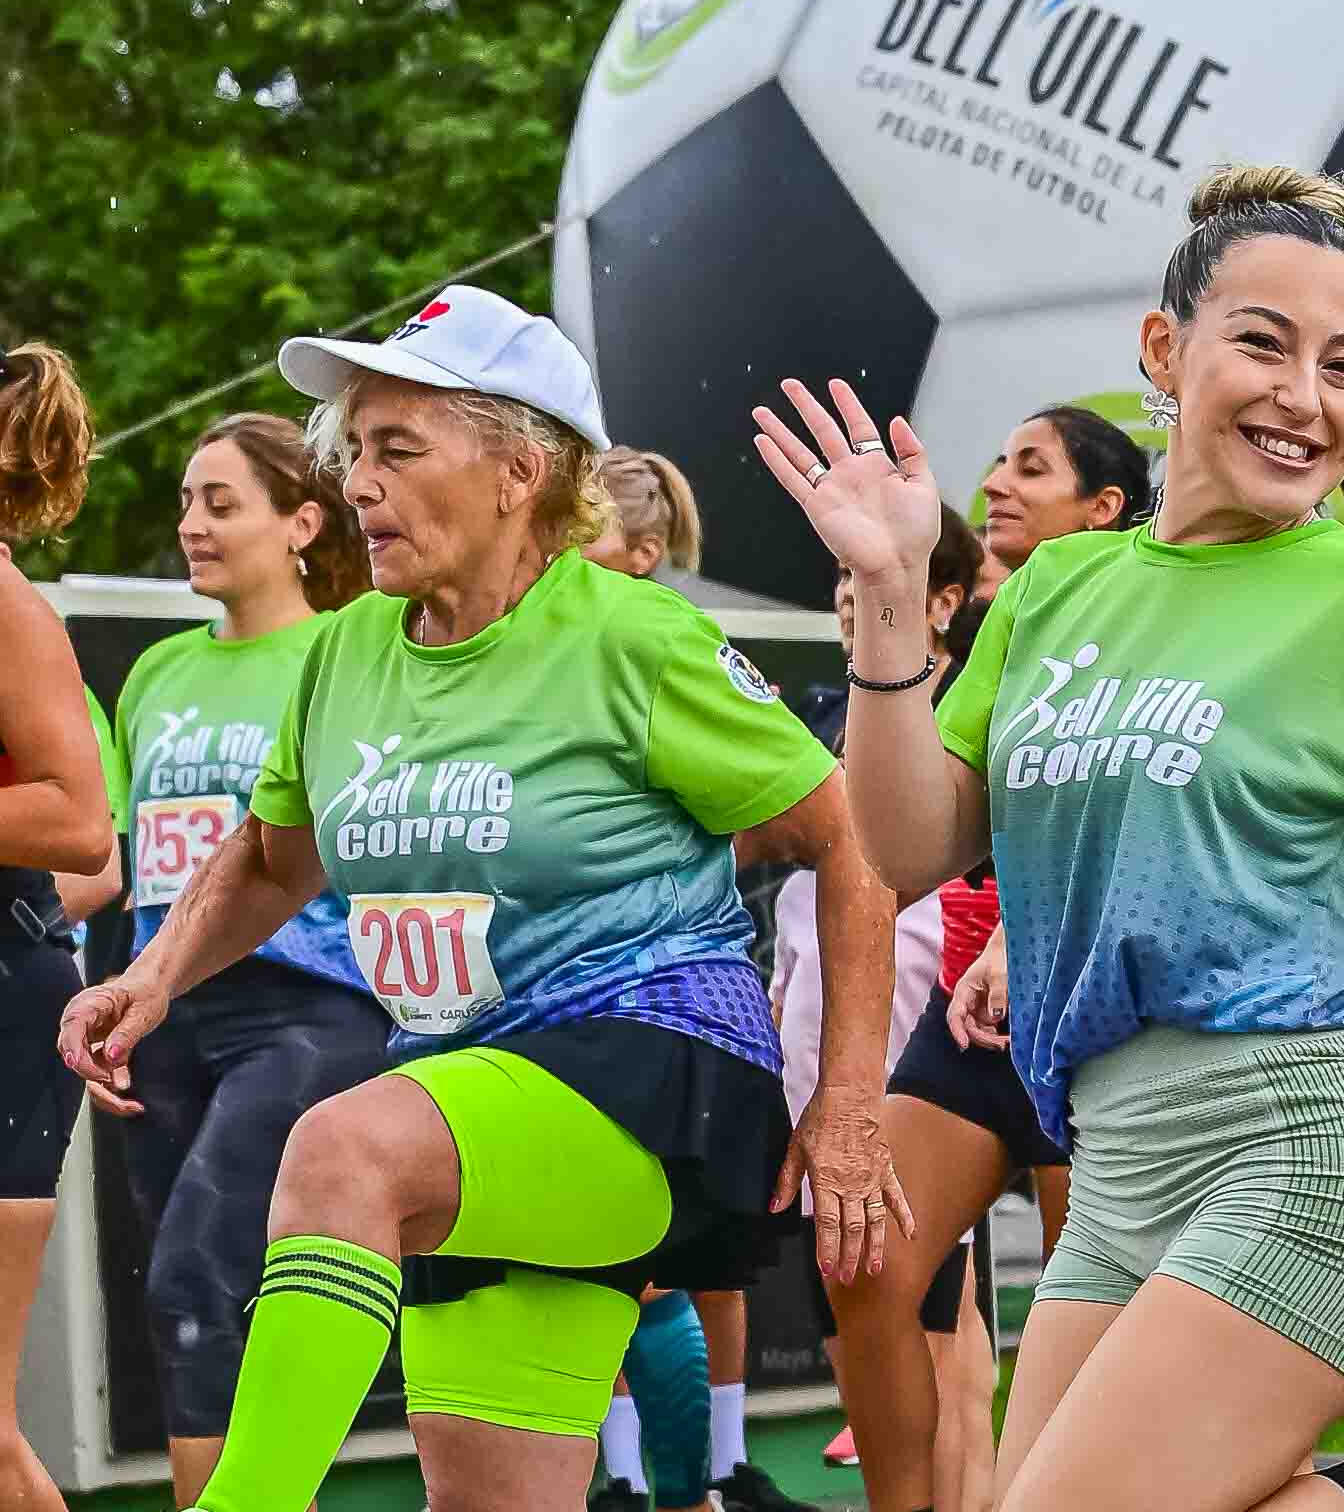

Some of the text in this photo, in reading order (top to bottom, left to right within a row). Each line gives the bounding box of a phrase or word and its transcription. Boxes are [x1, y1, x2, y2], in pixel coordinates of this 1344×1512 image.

[1028, 3, 1230, 170] VILLE
[856, 65, 949, 118] CAPITAL
[1091, 151, 1125, 190] DE
[1132, 176, 1167, 209] LA
[877, 110, 966, 158] PELOTA
[970, 143, 1006, 175] DE
[1117, 677, 1225, 745] Ville
[429, 760, 514, 814] Ville
[1006, 734, 1203, 789] corre
[336, 815, 512, 862] corre
[360, 908, 473, 997] 201
